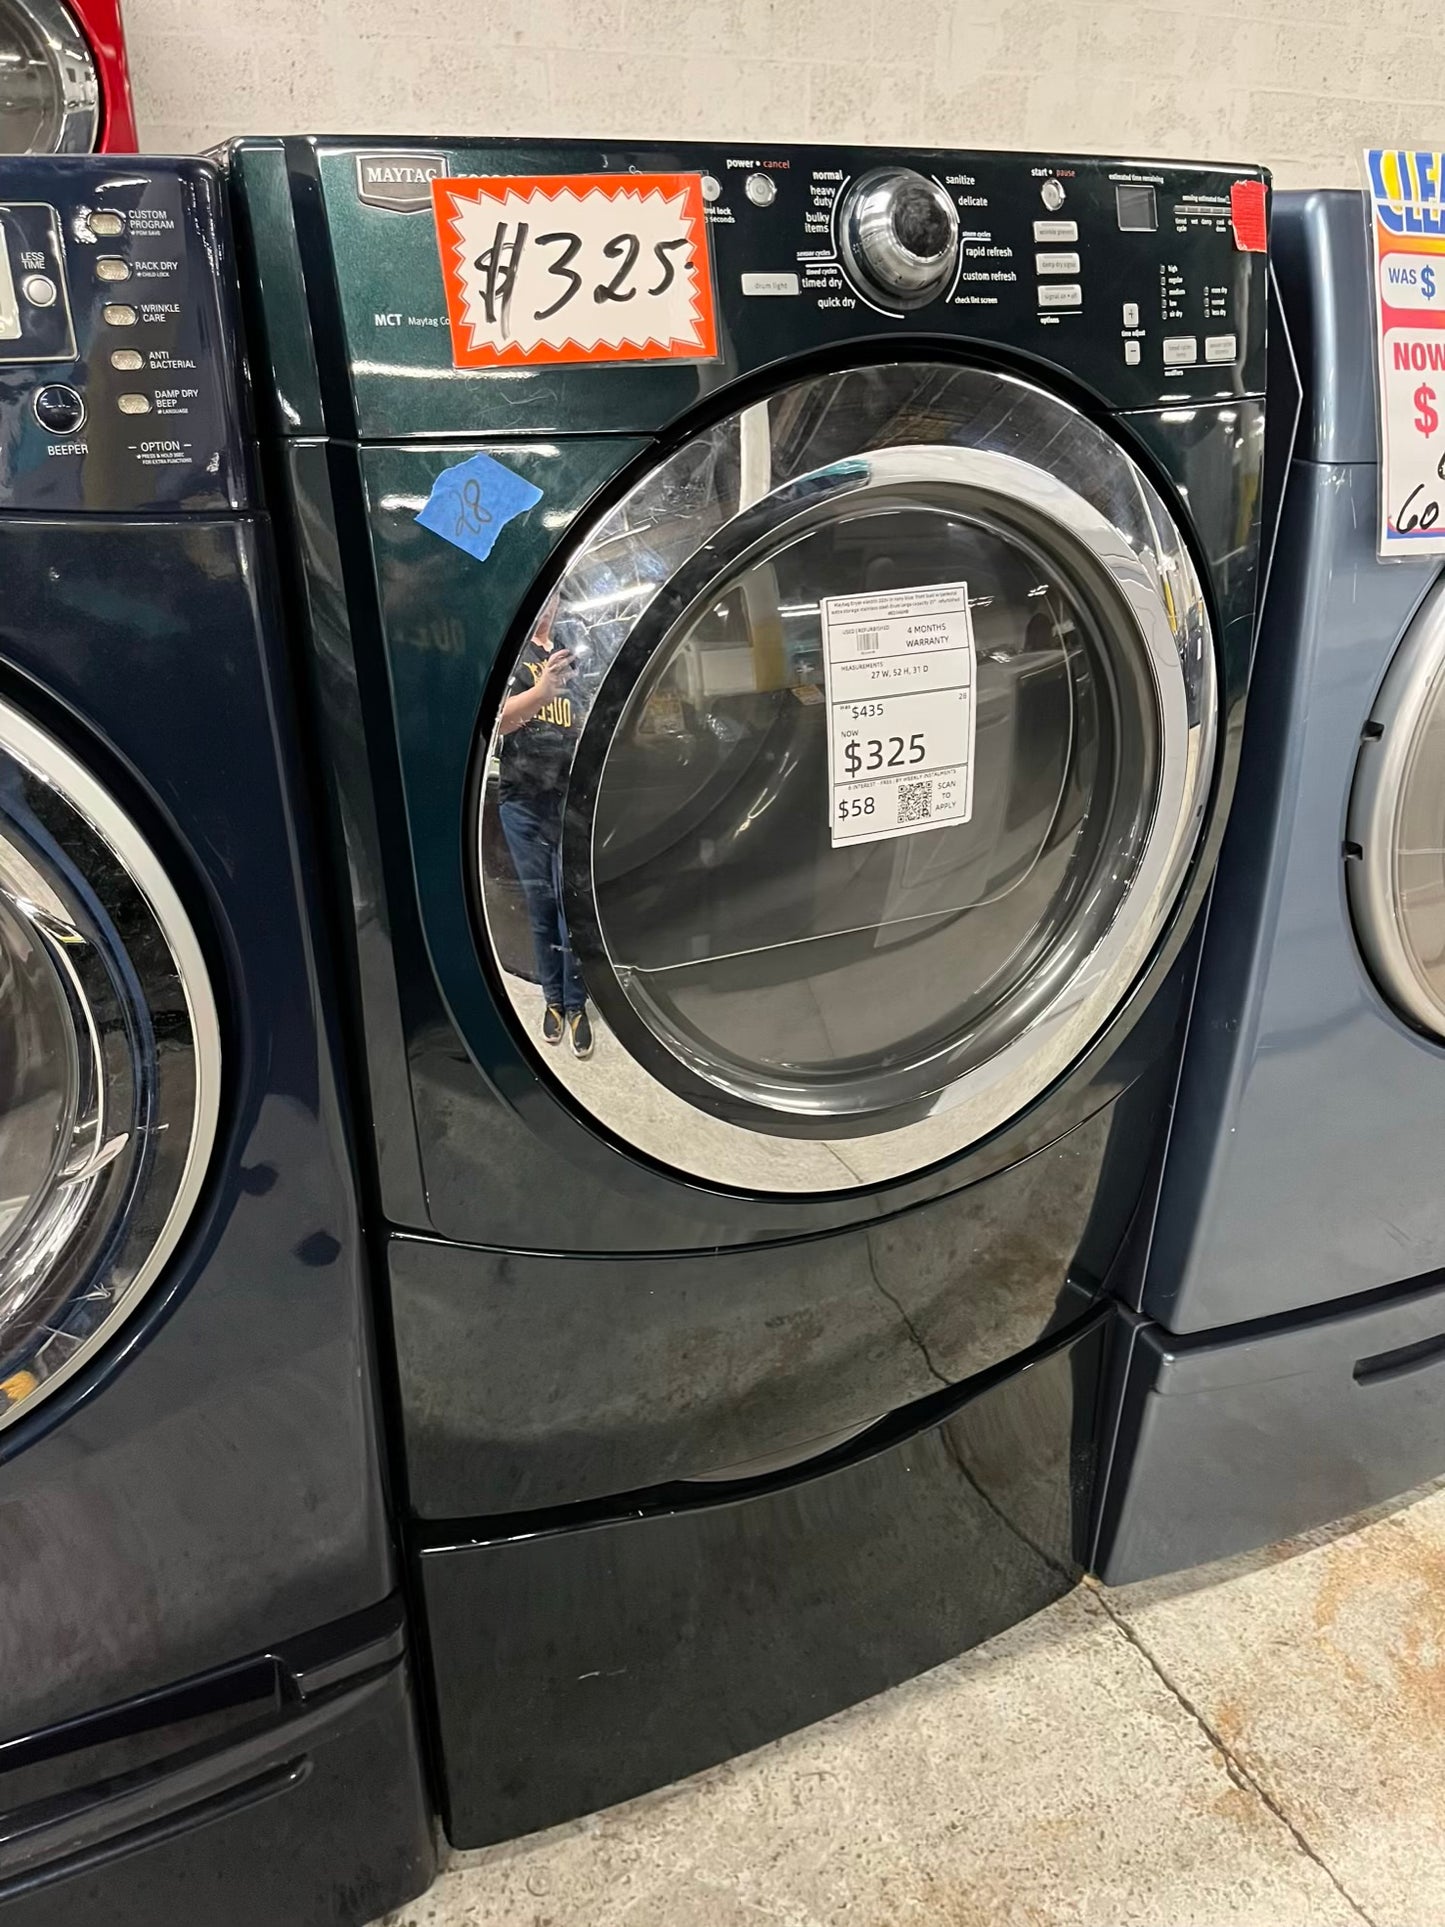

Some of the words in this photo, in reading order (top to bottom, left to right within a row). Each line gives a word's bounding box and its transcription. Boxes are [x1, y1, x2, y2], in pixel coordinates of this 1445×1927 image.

[727, 158, 754, 169] power
[763, 159, 790, 169] cancel
[812, 170, 843, 180] normal
[1031, 168, 1048, 177] start
[1056, 169, 1076, 178] pause
[945, 175, 975, 185] sanitize
[810, 185, 835, 198] heavy
[813, 196, 833, 208] duty
[958, 196, 988, 206] delicate
[128, 210, 167, 219] CUSTOM
[716, 206, 732, 215] lock
[709, 216, 736, 224] seconds
[806, 211, 830, 224] bulky
[130, 220, 175, 229] PROGRAM
[804, 223, 829, 233] items
[20, 252, 45, 261] LESS
[966, 247, 985, 258] rapid
[986, 246, 1013, 257] refresh
[21, 260, 46, 270] TIME
[135, 262, 159, 270] RACK
[160, 262, 178, 270] DRY
[962, 271, 990, 281] custom
[990, 271, 1017, 281] refresh
[772, 282, 788, 290] light
[802, 277, 827, 288] timed
[828, 276, 843, 289] dry
[1388, 267, 1417, 285] WAS
[1420, 264, 1436, 300] $
[817, 297, 841, 309] quick
[841, 296, 856, 309] dry
[954, 296, 970, 304] check
[141, 304, 181, 313] WRINKLE
[143, 314, 166, 322] CARE
[374, 313, 402, 326] MCT
[408, 316, 439, 328] Maytag
[149, 351, 170, 360] ANTI
[1393, 342, 1445, 371] NOW
[150, 360, 197, 369] BACTERIAL
[155, 390, 180, 399] DAMP
[181, 389, 199, 398] DRY
[156, 399, 177, 408] BEEP
[1414, 382, 1438, 439] $
[47, 444, 89, 457] BEEPER
[140, 441, 180, 452] OPTION
[449, 479, 493, 537] 28
[858, 625, 890, 633] REFURBISHED
[907, 626, 912, 634] 4
[914, 623, 946, 634] MONTHS
[906, 636, 949, 648] WARRANTY
[841, 662, 883, 671] MEASUREMENTS
[871, 671, 880, 679] 27
[882, 670, 891, 678] W,
[893, 669, 902, 677] 52
[903, 667, 911, 675] H,
[913, 666, 921, 674] 31
[923, 665, 929, 673] D
[852, 703, 884, 719] $435
[841, 729, 859, 738] NOW
[844, 733, 926, 778] $325
[852, 781, 876, 790] INTEREST
[903, 774, 922, 782] WEEKLY
[938, 780, 956, 790] SCAN
[838, 796, 875, 822] $58
[935, 801, 957, 811] APPLY
